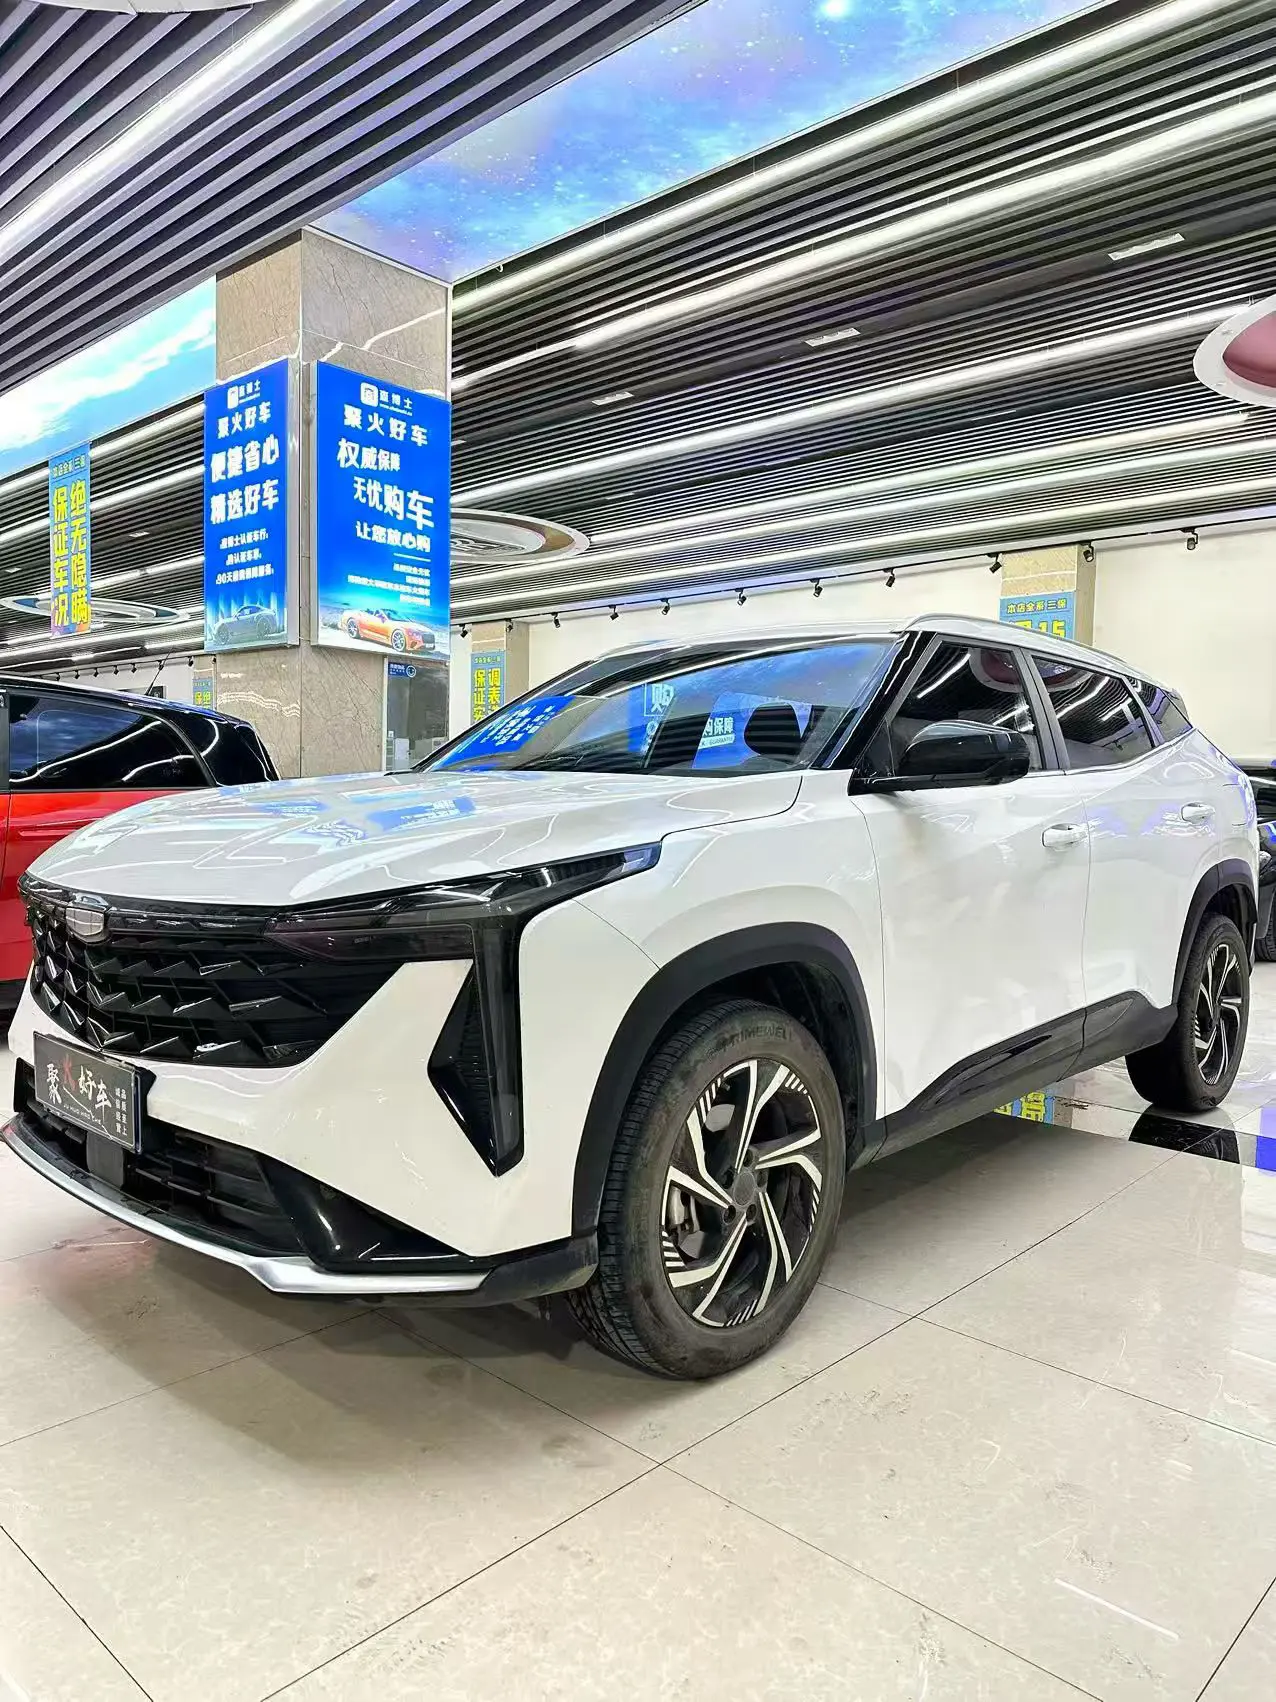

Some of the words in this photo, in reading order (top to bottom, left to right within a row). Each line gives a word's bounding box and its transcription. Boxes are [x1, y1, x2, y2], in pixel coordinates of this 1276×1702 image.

[217, 401, 271, 439] 聚火好车
[344, 404, 428, 447] 聚火好车
[210, 433, 280, 483] 便捷省心
[337, 438, 401, 472] 权威保障
[210, 479, 280, 525] 精选好车
[353, 475, 435, 531] 无忧购车
[52, 485, 70, 627] 保证车况
[69, 479, 88, 625] 绝无隐瞒
[355, 520, 431, 553] 让您放心购
